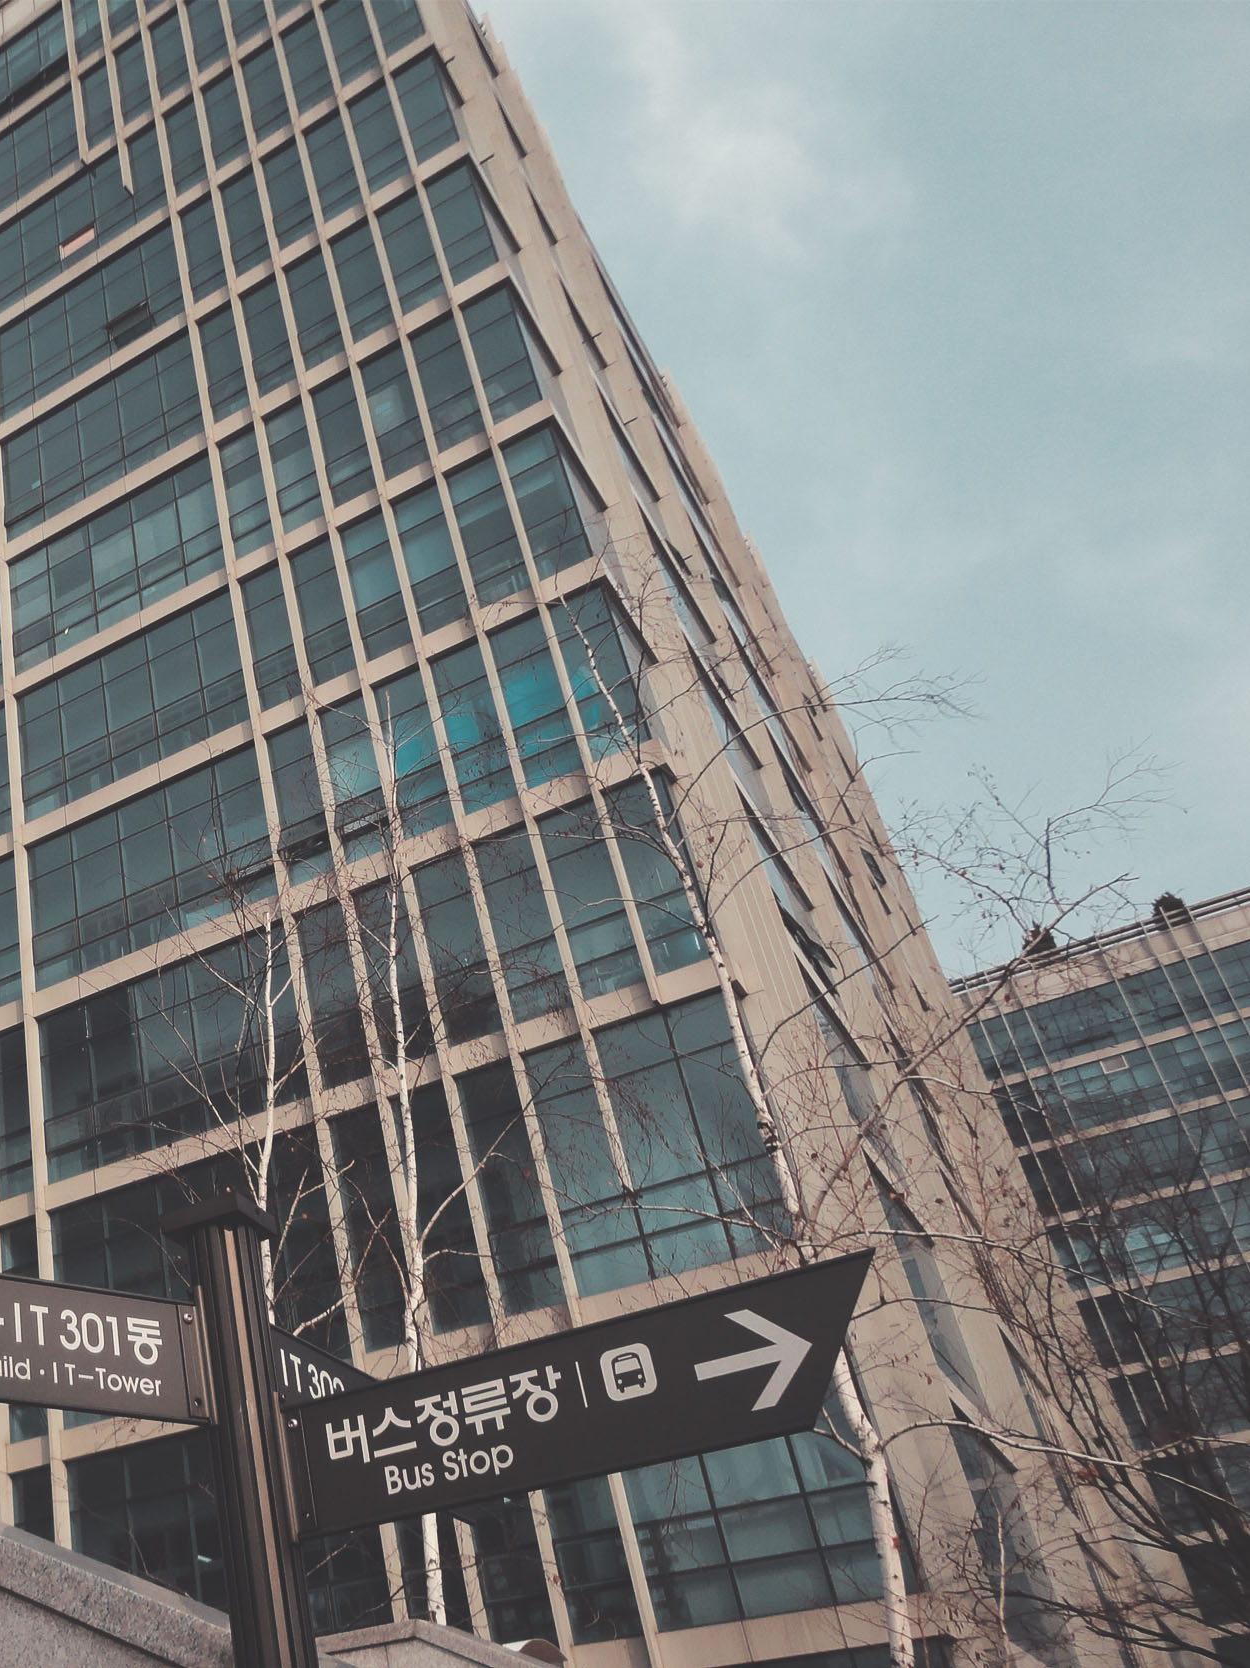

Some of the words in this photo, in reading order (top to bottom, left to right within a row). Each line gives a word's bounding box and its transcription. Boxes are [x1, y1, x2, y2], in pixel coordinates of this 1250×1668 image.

[58, 1308, 164, 1366] 301동
[325, 1365, 562, 1464] 버스정류장
[384, 1462, 435, 1496] Bus
[442, 1444, 514, 1481] Stop
